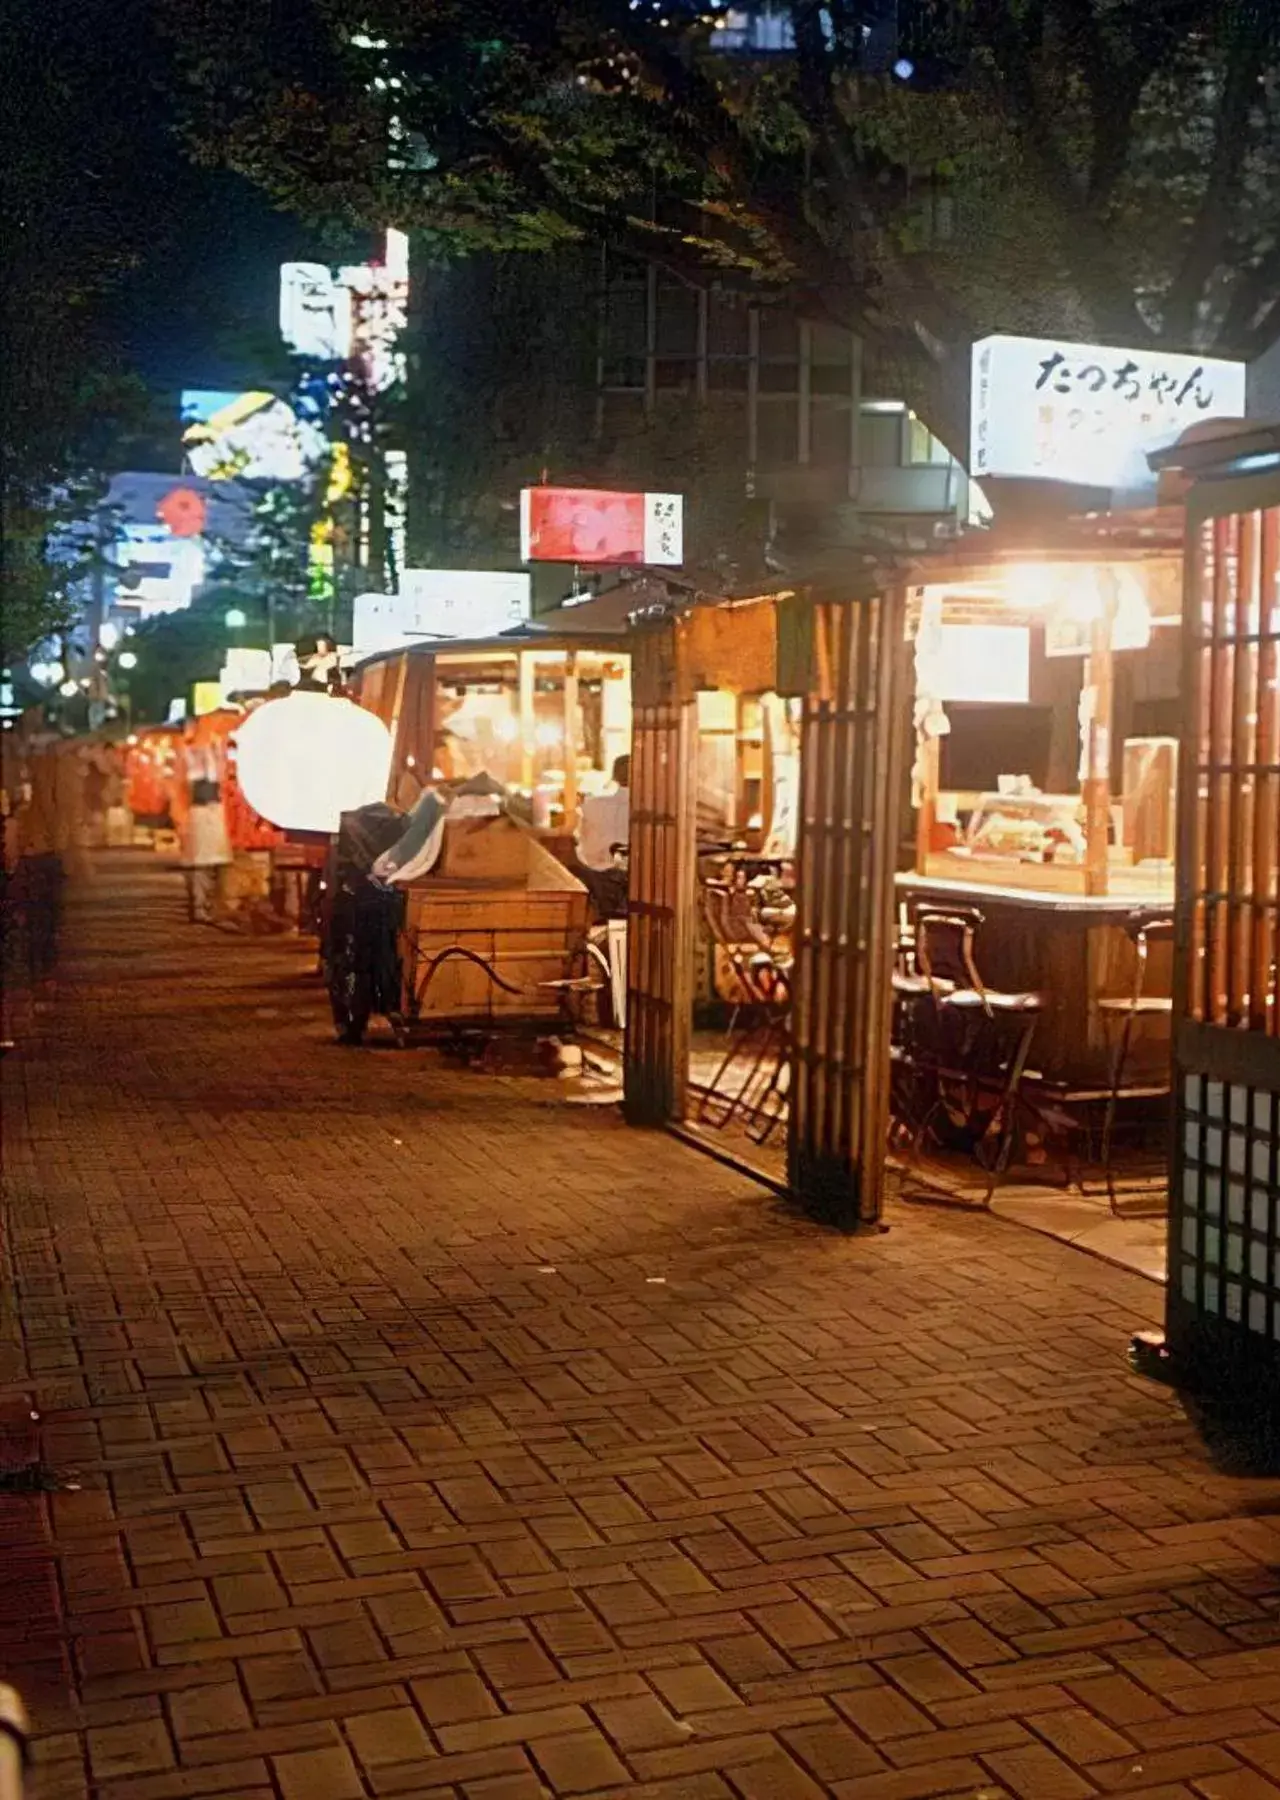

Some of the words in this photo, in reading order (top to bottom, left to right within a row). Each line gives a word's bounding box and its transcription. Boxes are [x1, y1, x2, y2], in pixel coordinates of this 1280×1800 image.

[1034, 350, 1215, 410] たつちゃん
